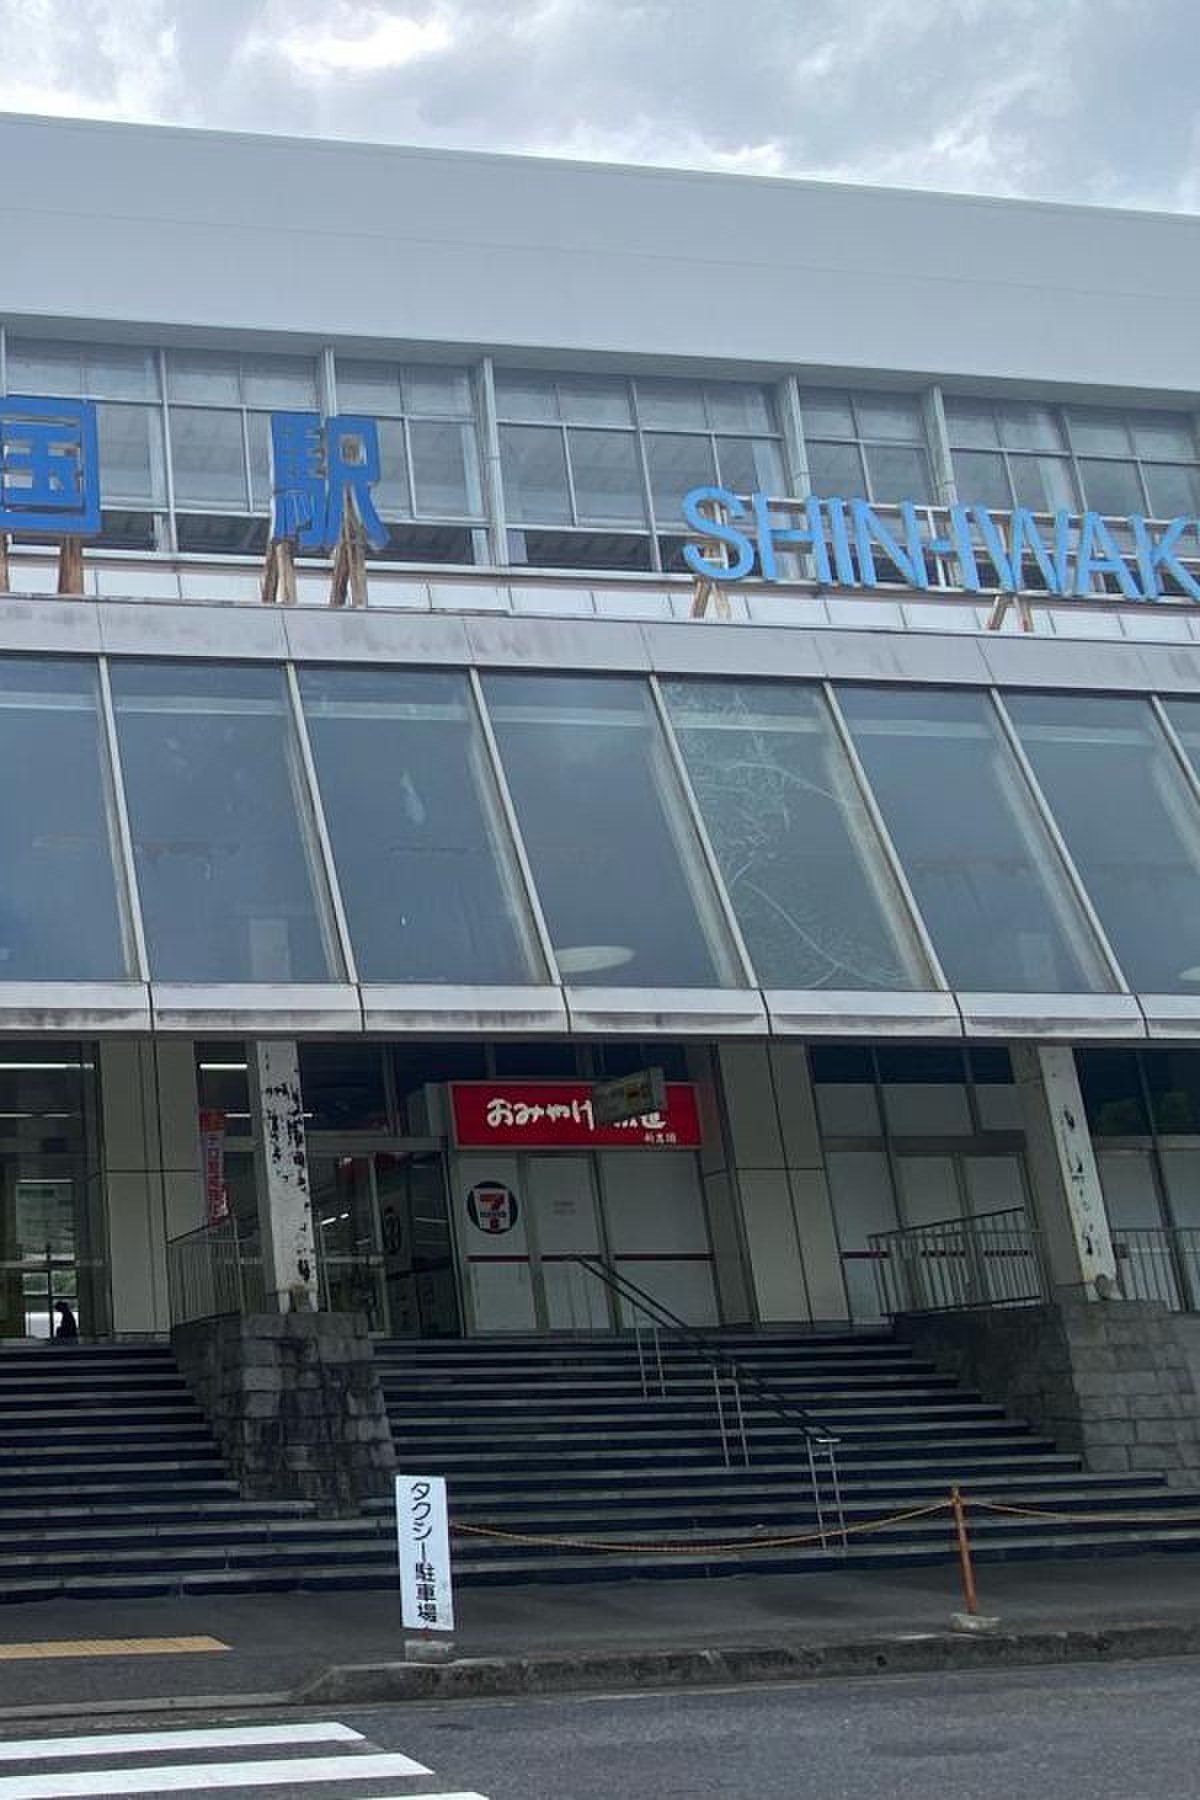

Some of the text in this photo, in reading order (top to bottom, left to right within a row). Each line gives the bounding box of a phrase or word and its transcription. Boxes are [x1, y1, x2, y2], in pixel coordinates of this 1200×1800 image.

[682, 486, 1200, 602] SHIN-IWAK
[411, 1482, 438, 1623] タクシー駐車場
